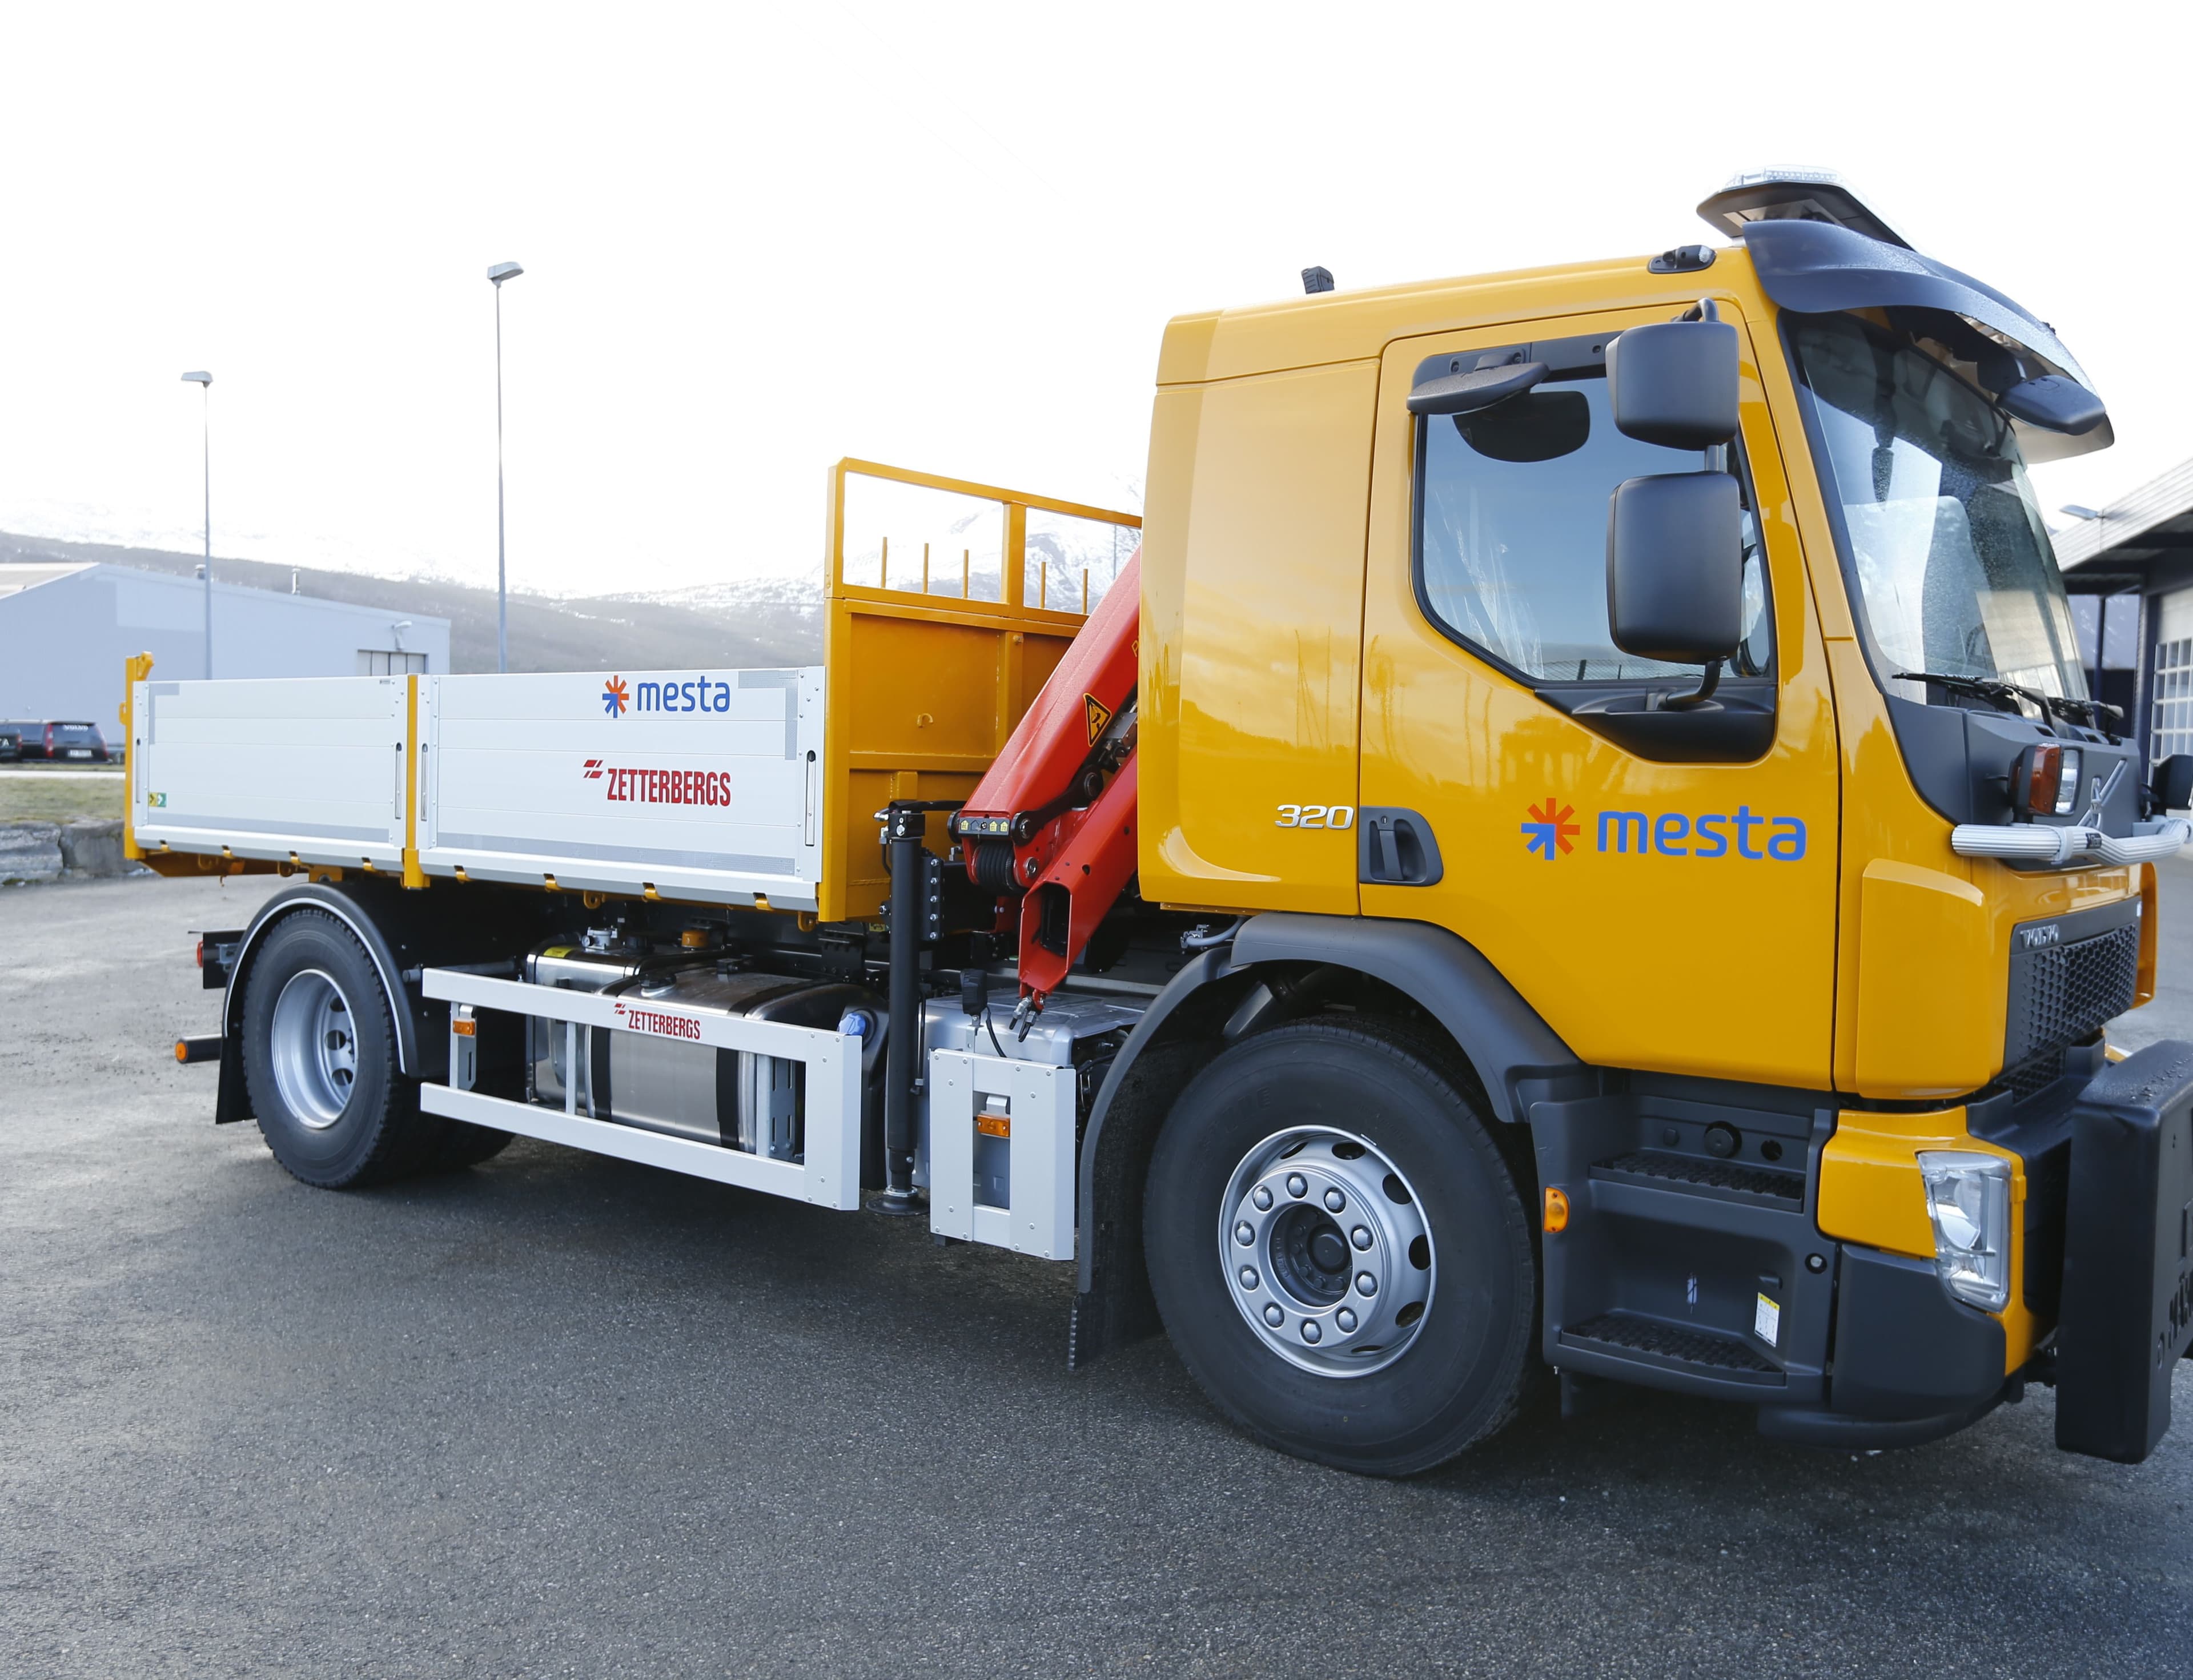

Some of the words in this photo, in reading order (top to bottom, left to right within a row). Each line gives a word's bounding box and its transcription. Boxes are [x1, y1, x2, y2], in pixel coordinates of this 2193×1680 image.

[637, 676, 730, 712] mesta
[607, 768, 731, 806] ZETTERBERGS
[1275, 804, 1355, 830] 320
[1597, 805, 1807, 861] mesta
[629, 1010, 700, 1039] ZETTERBERGS
